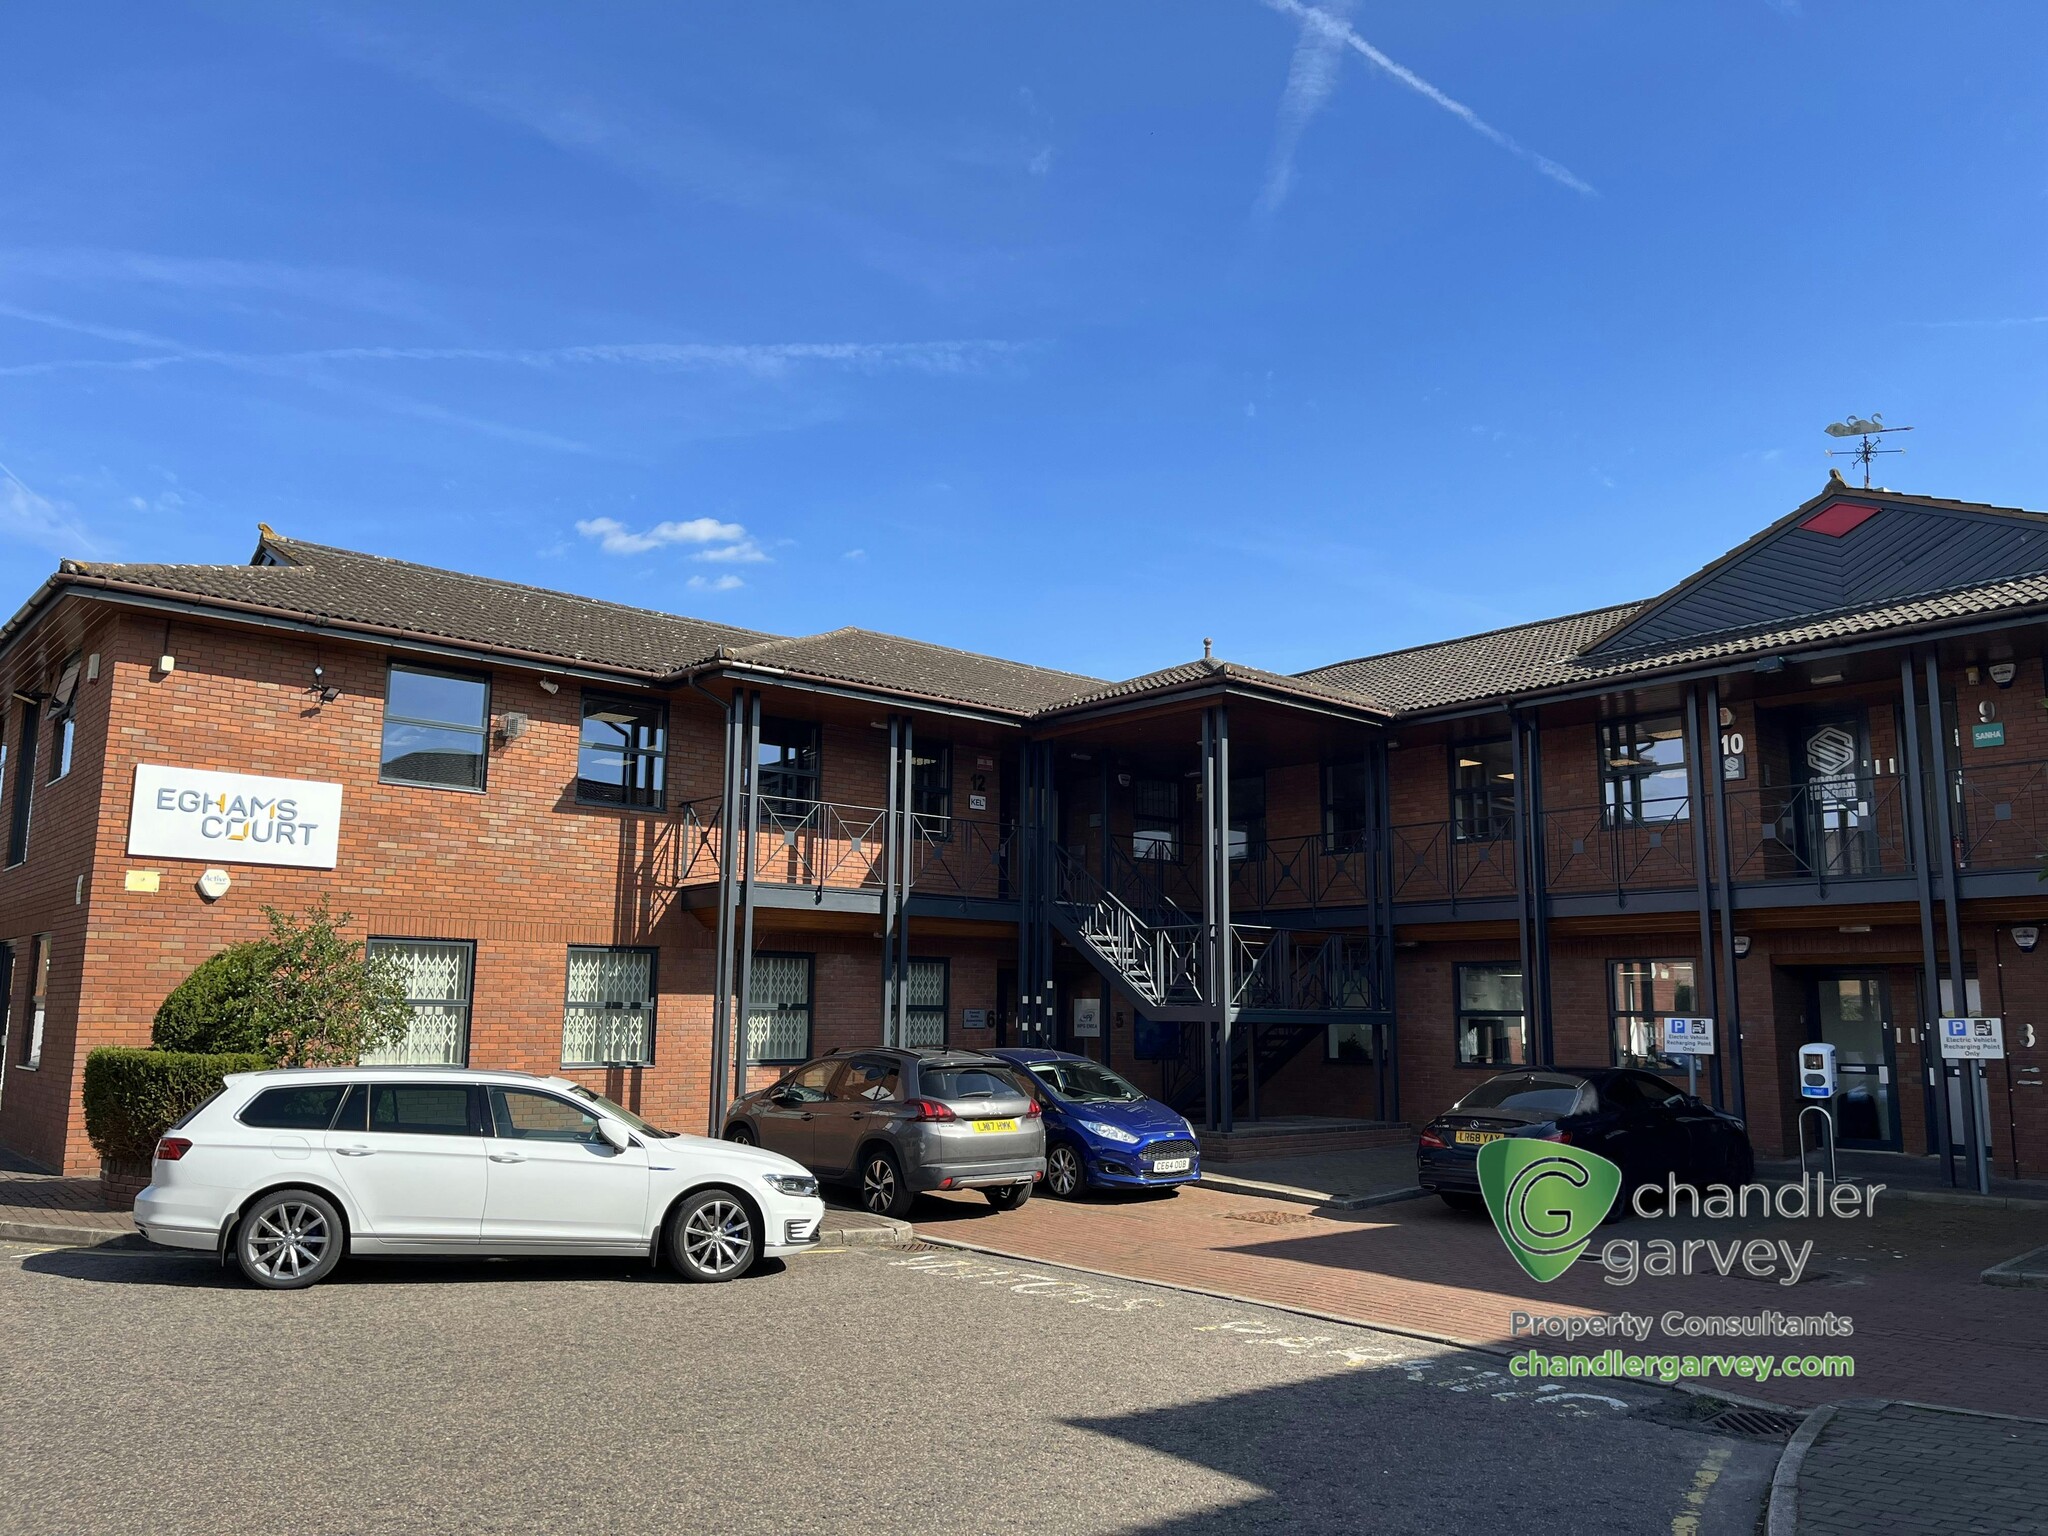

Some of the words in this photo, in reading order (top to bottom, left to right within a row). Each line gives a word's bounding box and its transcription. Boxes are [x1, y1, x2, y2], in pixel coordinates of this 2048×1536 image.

[1979, 700, 1995, 722] 9
[1721, 733, 1744, 755] 10
[1975, 730, 2002, 741] SANHA
[971, 774, 985, 791] 12
[156, 787, 298, 821] EGHAMS
[202, 815, 318, 846] COURT
[986, 1010, 996, 1029] 6
[2018, 1023, 2036, 1048] 3
[1459, 1132, 1481, 1143] LR68
[1156, 1161, 1173, 1171] CE64
